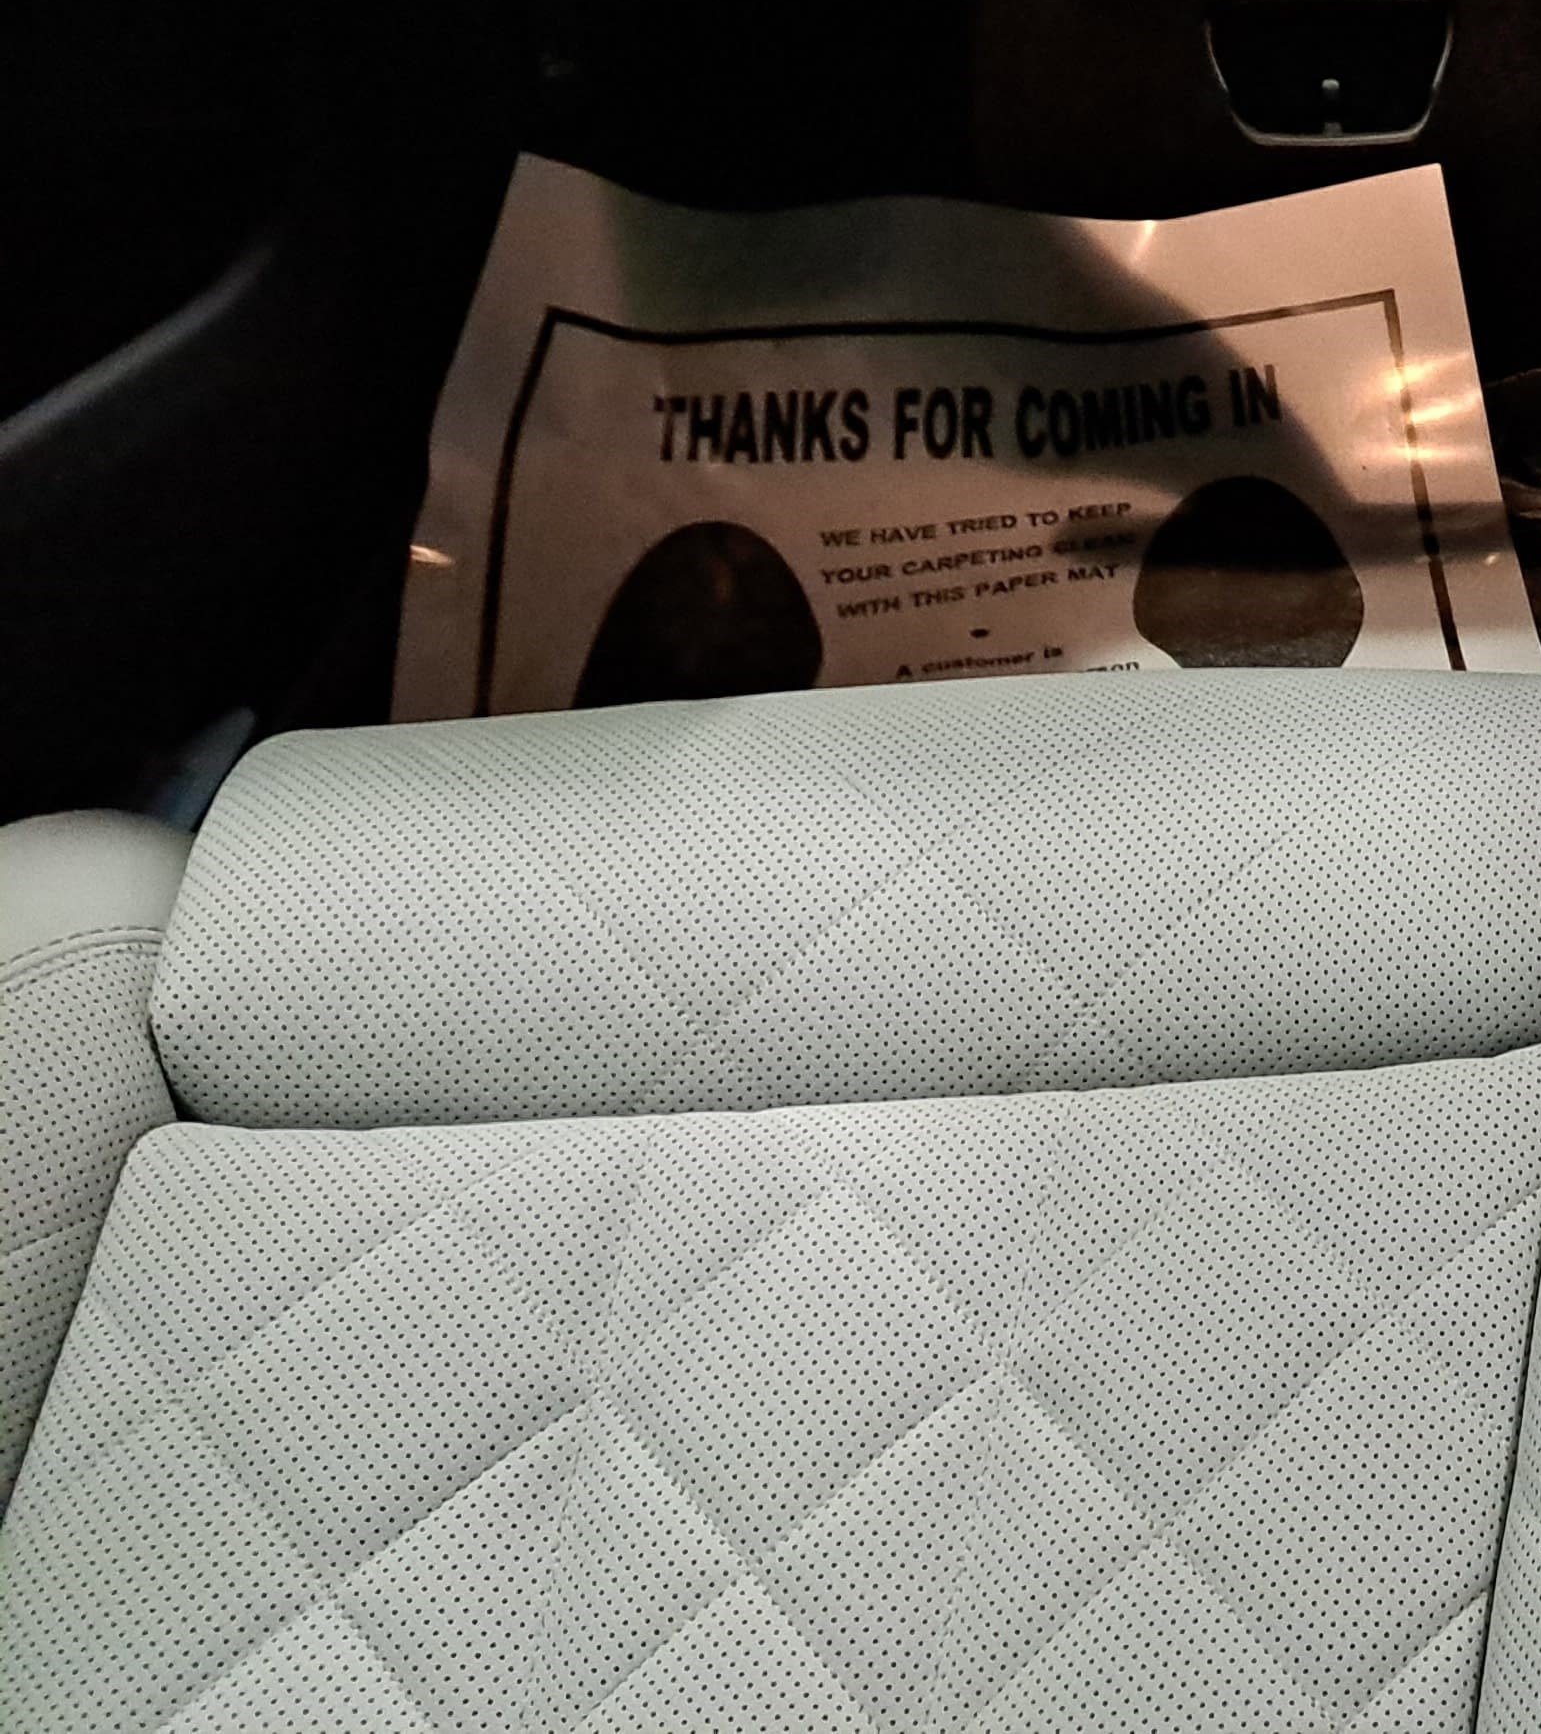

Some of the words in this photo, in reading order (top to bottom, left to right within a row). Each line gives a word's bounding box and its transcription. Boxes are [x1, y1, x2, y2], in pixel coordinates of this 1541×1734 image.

[653, 388, 870, 464] THANKS
[893, 385, 995, 460] FOR
[1015, 376, 1210, 459] COMING
[1230, 364, 1283, 428] IN
[820, 528, 861, 548] WE
[870, 523, 936, 545] HAVE
[947, 514, 1017, 535] TRIED
[1026, 511, 1058, 528] TO
[1067, 502, 1131, 524] KEEP
[821, 565, 891, 585] YOUR
[901, 545, 1043, 576] CARPETING
[837, 596, 901, 619] WITH
[910, 587, 965, 609] THIS
[974, 571, 1058, 598] PAPER
[1067, 565, 1119, 582] MAT
[897, 665, 912, 678] A
[921, 651, 1035, 673] customer
